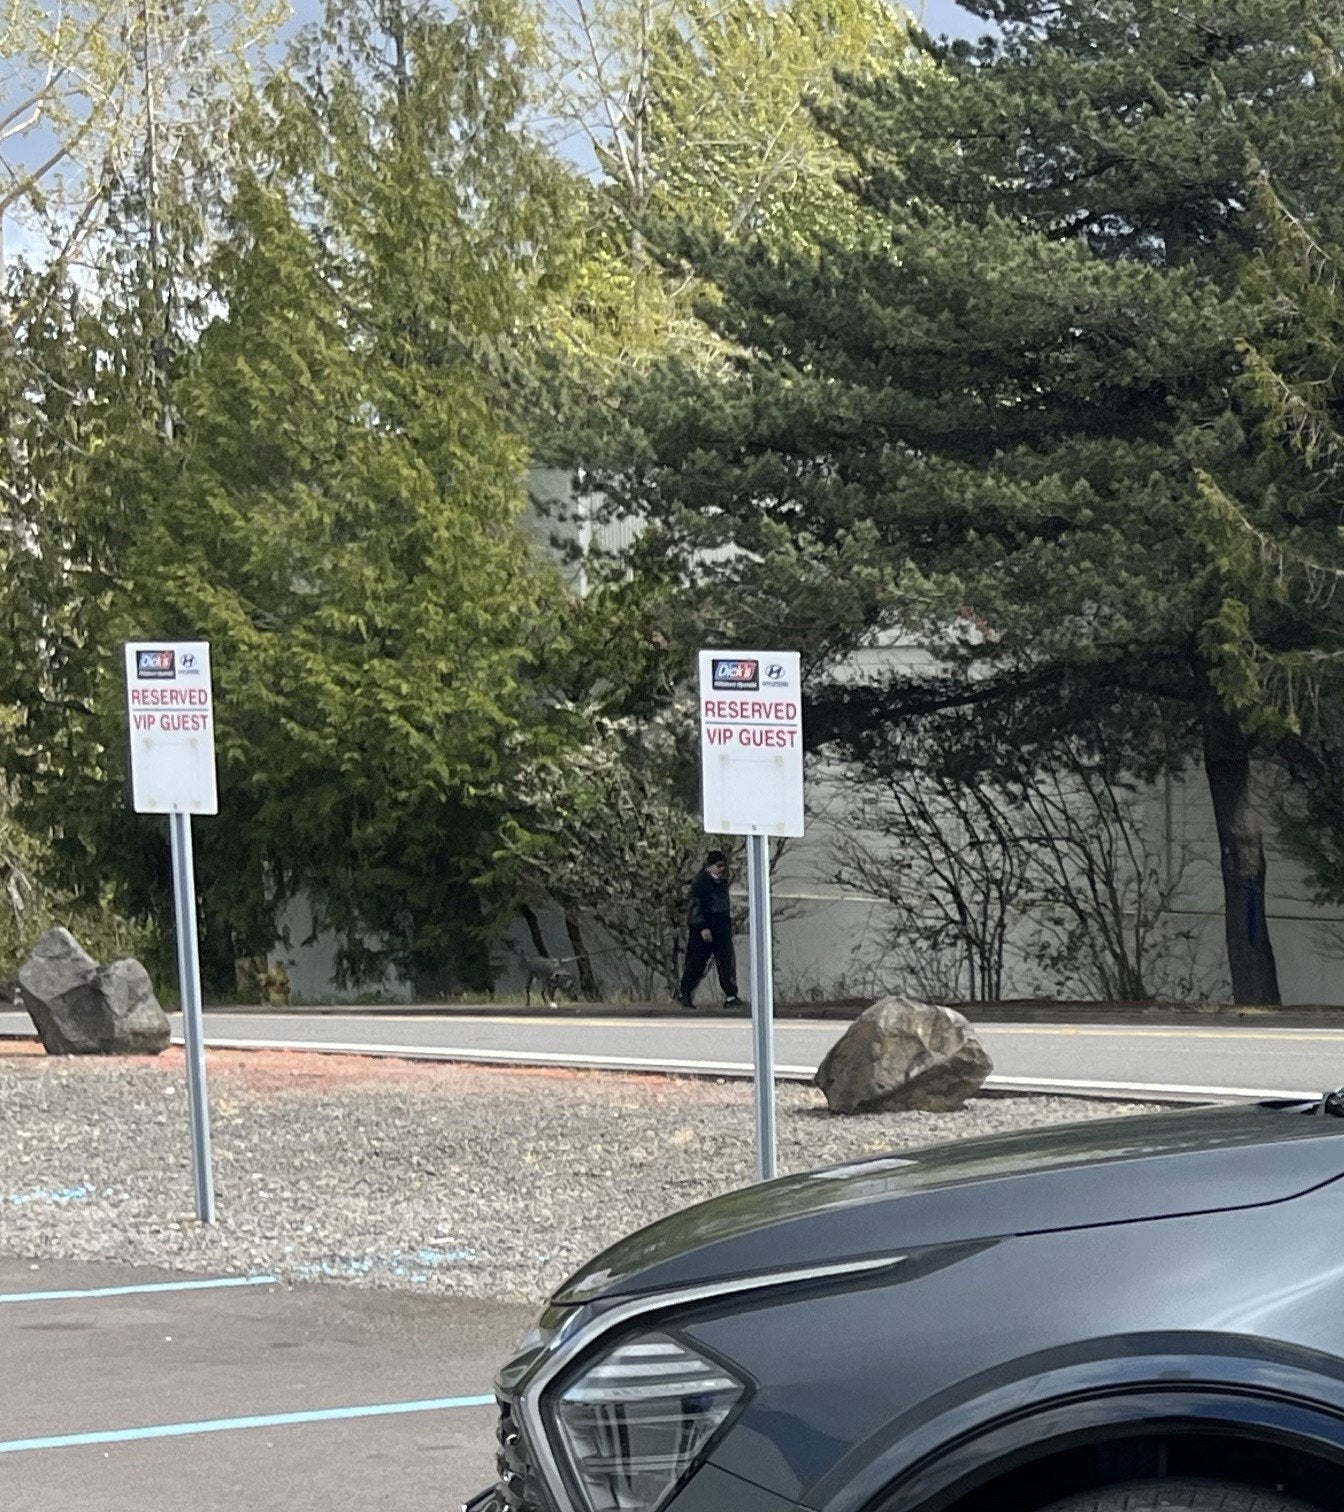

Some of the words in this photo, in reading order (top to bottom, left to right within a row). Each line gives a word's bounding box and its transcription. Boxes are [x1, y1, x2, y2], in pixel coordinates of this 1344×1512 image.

[131, 689, 208, 706] RESERVED
[704, 700, 797, 720] RESERVED
[133, 714, 156, 731] VIP
[160, 713, 209, 731] GUEST
[706, 727, 733, 746] VIP
[738, 728, 798, 748] GUEST
